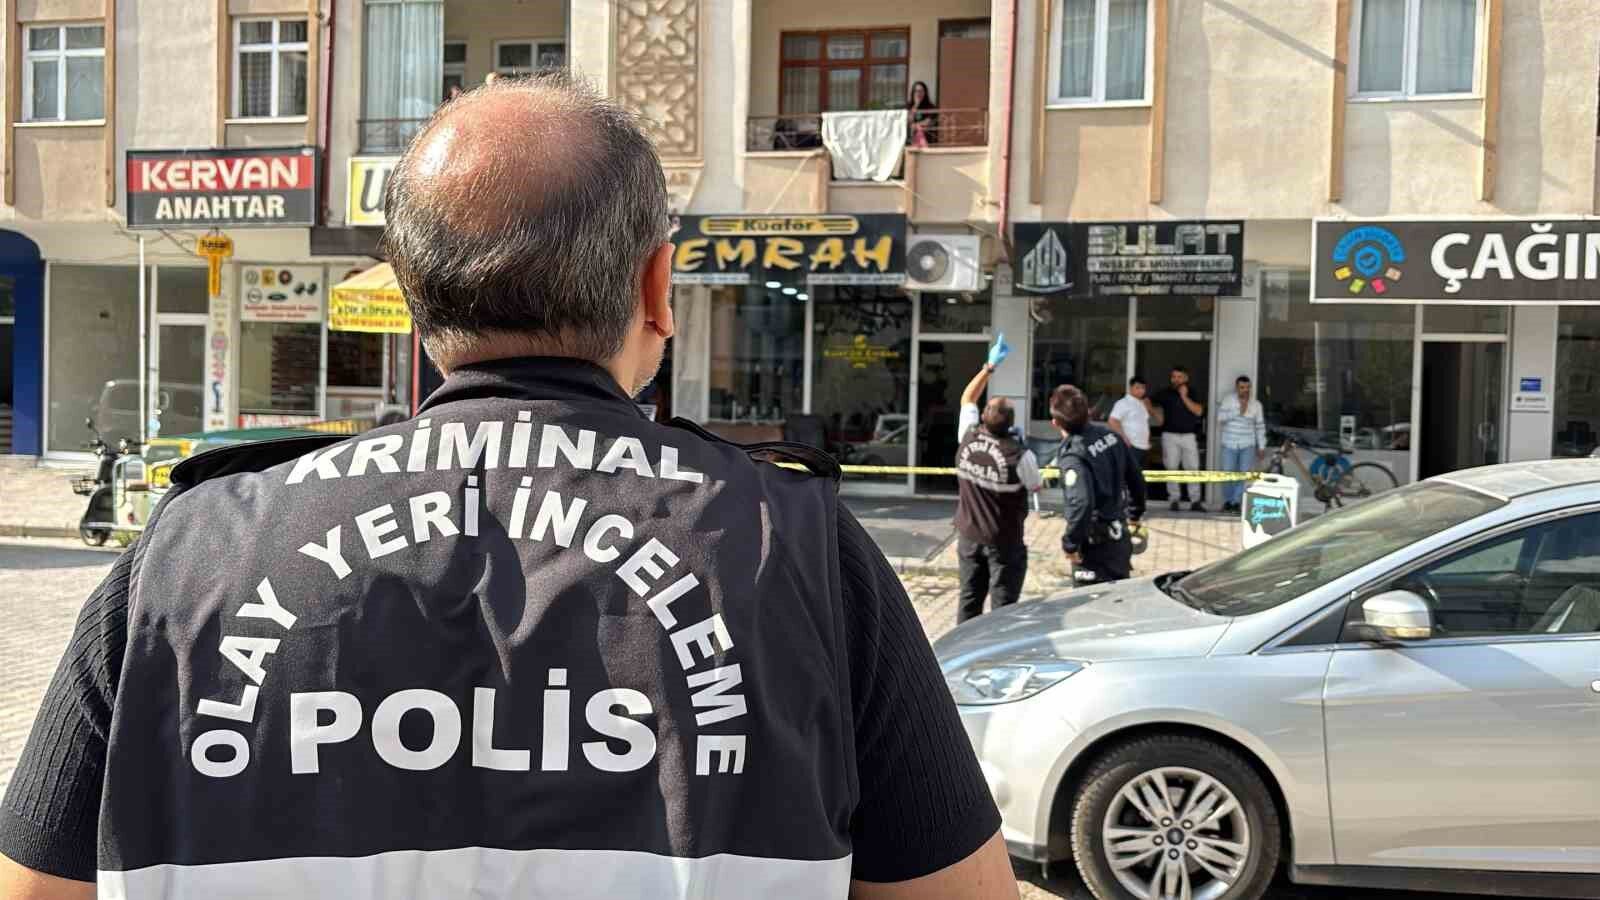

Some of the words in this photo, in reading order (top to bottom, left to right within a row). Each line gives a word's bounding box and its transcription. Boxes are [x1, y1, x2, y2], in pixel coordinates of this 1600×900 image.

[142, 157, 299, 191] KERVAN
[155, 195, 286, 220] ANAHTAR
[675, 235, 893, 272] EMRAH
[1088, 224, 1241, 255] BULAT
[284, 410, 704, 486] KRİMİNAL
[192, 577, 297, 777] OLAY
[298, 475, 480, 579] YERİ
[508, 475, 748, 776] İNCELEME
[291, 669, 657, 773] POLİS
